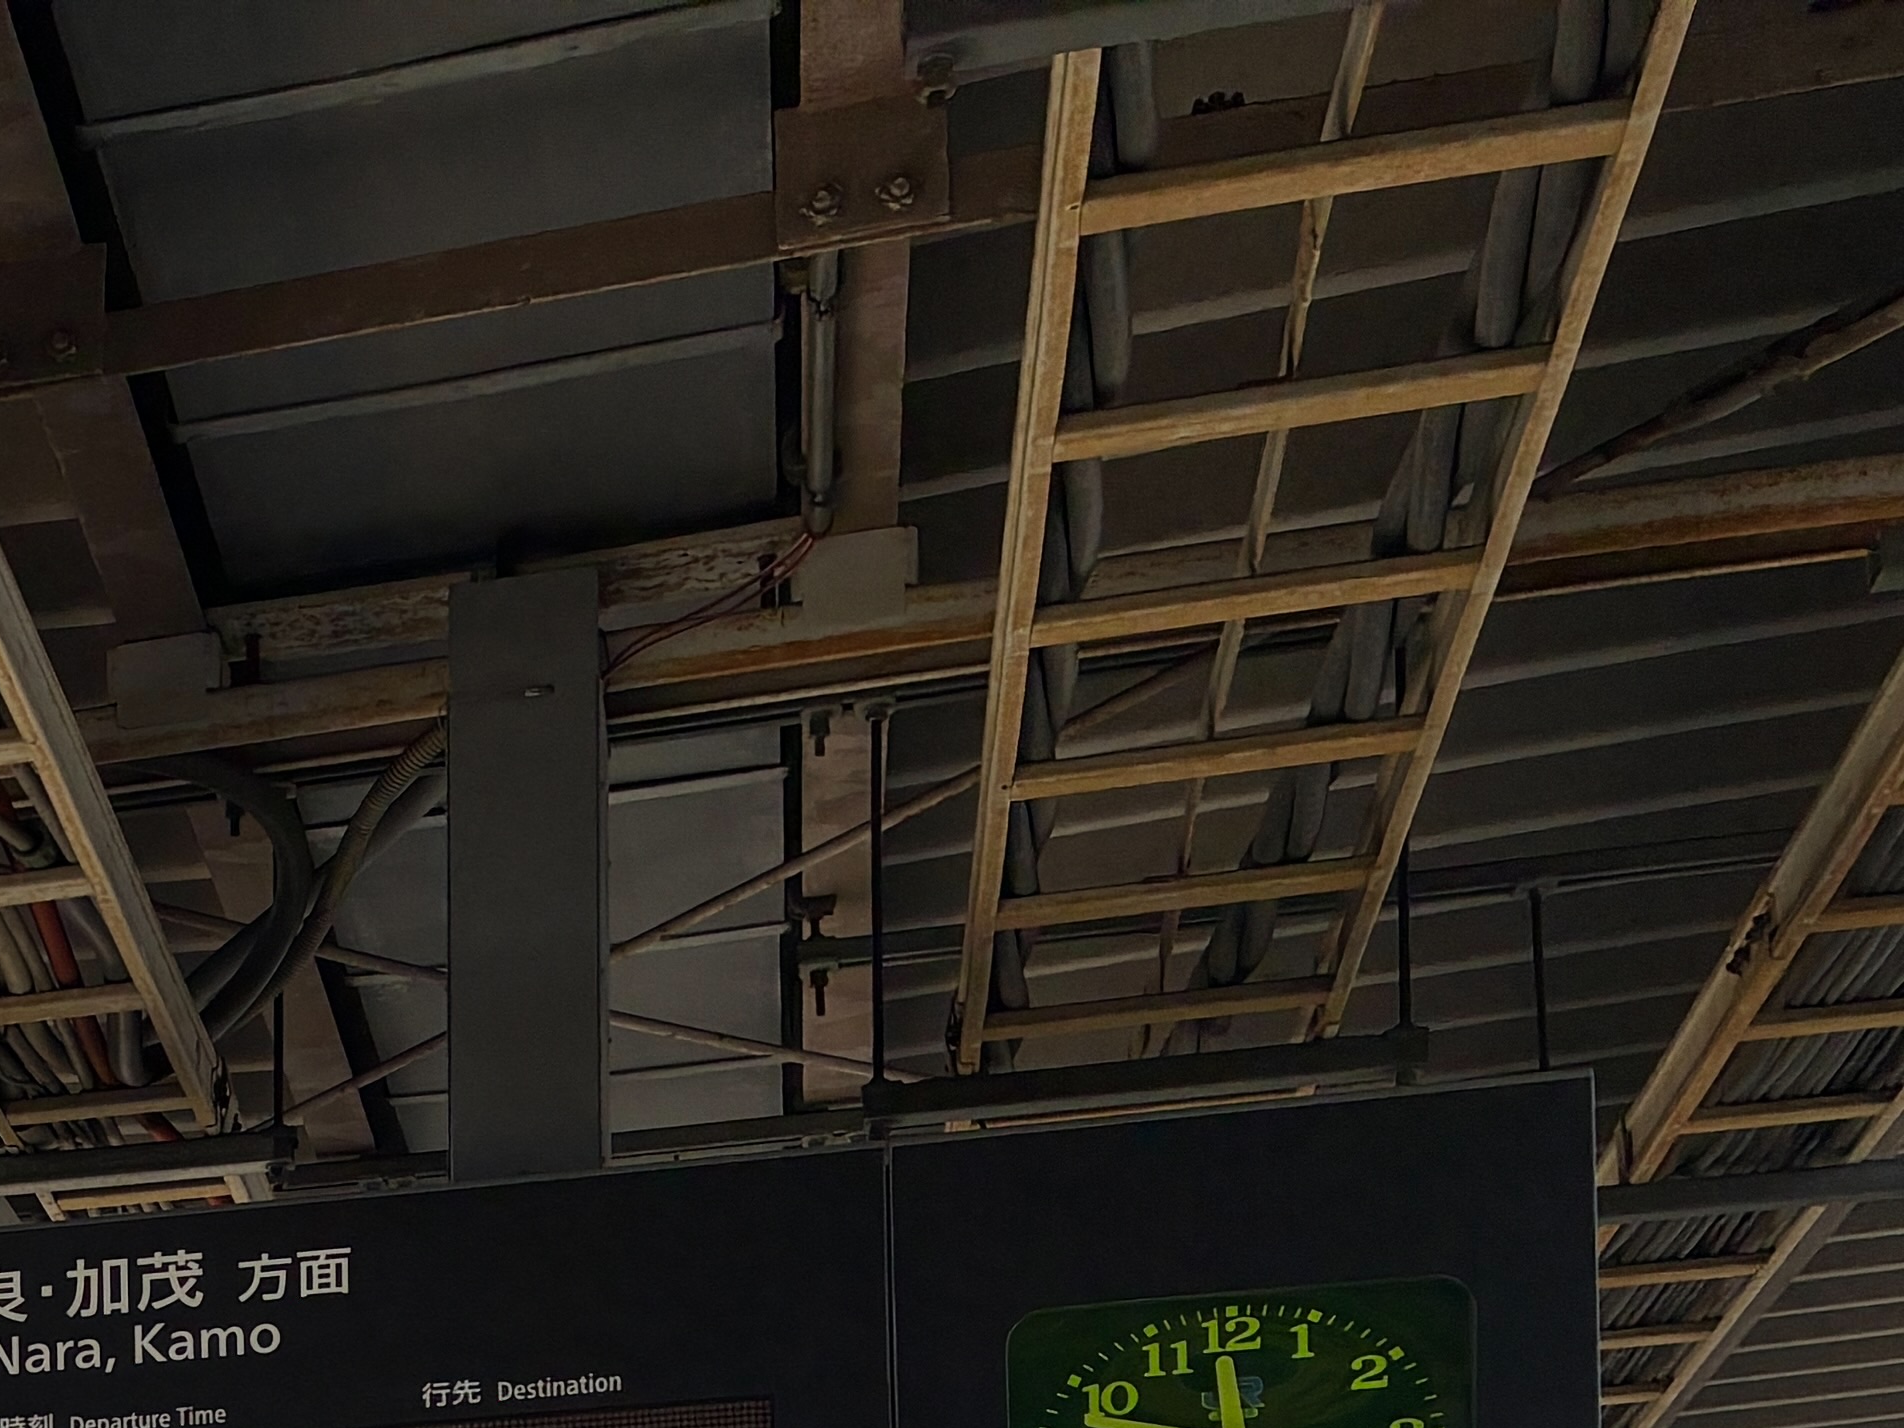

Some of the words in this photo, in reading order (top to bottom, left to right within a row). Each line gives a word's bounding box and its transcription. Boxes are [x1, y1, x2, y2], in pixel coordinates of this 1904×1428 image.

[238, 1247, 352, 1302] 方面
[133, 1321, 281, 1364] Kamo
[1201, 1317, 1261, 1353] 12
[1290, 1325, 1314, 1359] 1
[1143, 1341, 1195, 1377] 11
[1350, 1356, 1388, 1391] 2
[421, 1380, 482, 1408] 行先
[497, 1372, 623, 1403] Destination
[1083, 1381, 1138, 1418] 10
[173, 1404, 228, 1428] Time
